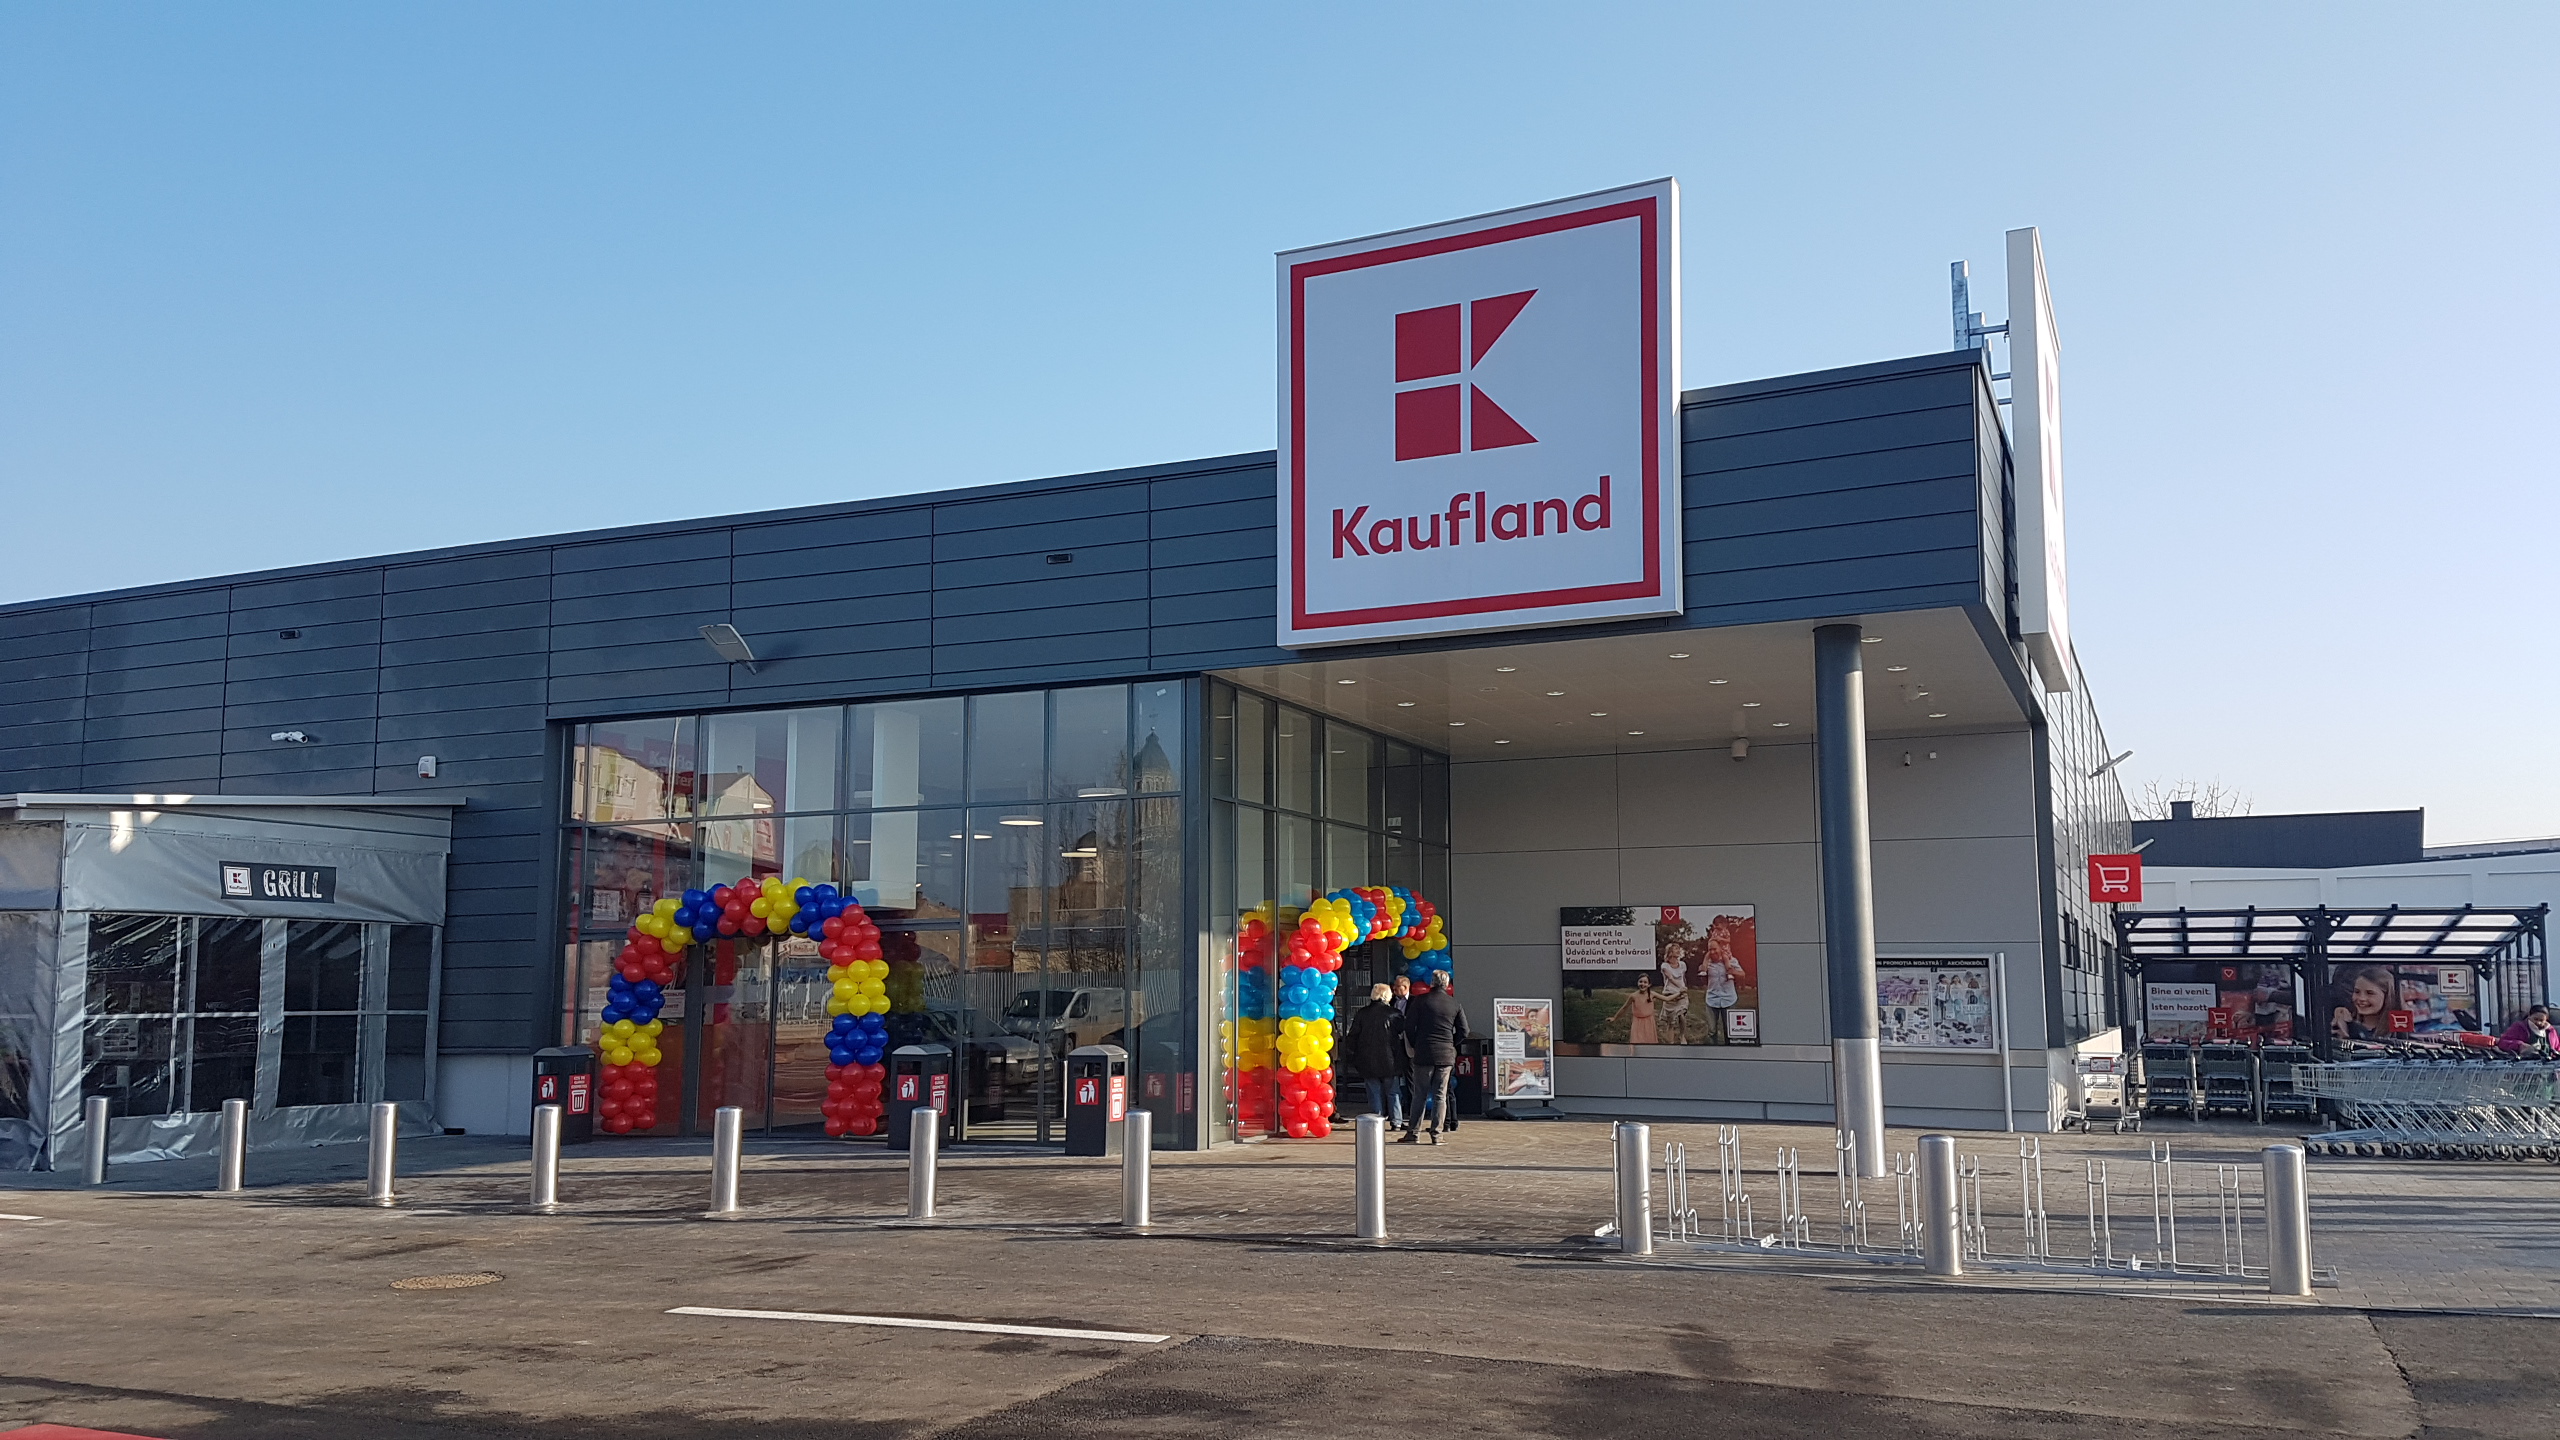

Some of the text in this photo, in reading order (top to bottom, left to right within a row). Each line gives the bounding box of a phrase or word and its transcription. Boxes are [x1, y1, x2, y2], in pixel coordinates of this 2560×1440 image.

[1332, 474, 1611, 560] Kaufland
[263, 869, 322, 899] GRILL
[1602, 938, 1632, 946] Centru!
[1565, 947, 1606, 956] Üdvözlünk
[1615, 948, 1651, 956] belvárosi
[2151, 987, 2212, 996] Bine ai venit.
[2151, 1002, 2175, 1011] Isten
